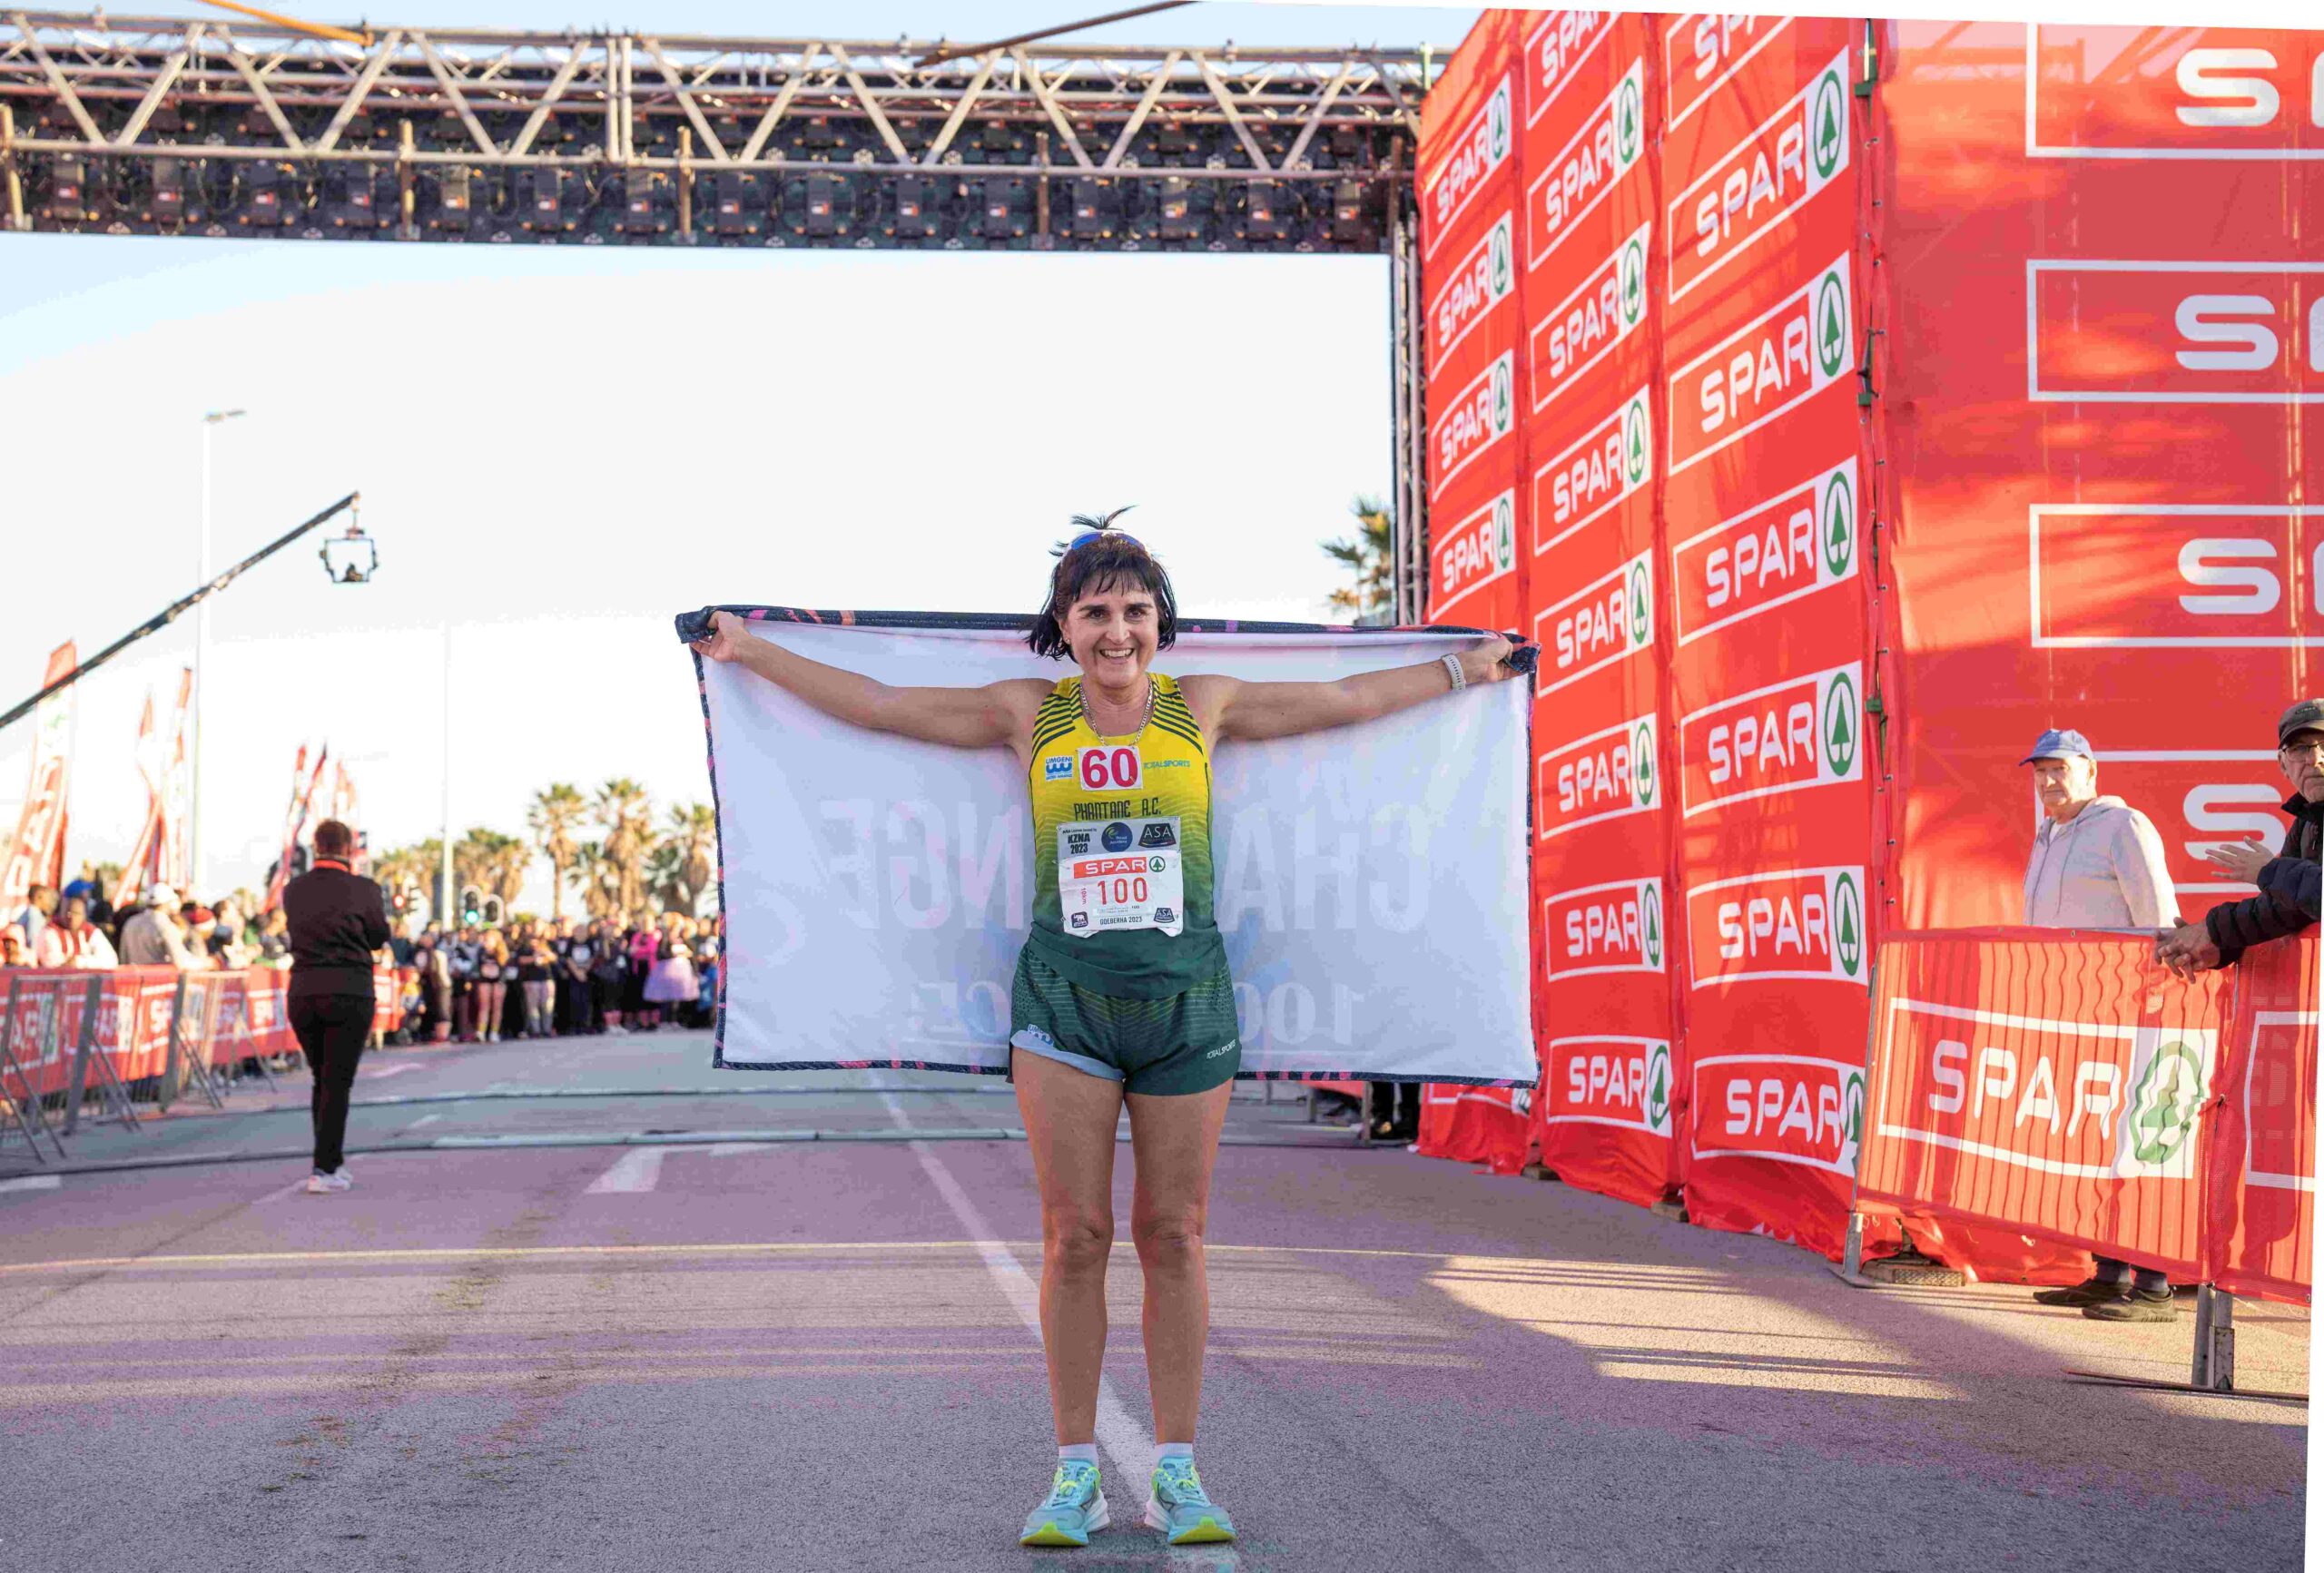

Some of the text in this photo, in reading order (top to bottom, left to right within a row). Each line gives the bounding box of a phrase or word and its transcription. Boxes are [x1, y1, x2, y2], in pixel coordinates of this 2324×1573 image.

[2175, 48, 2324, 128] S
[1437, 125, 1489, 224] SPAR
[1546, 119, 1614, 232] SPAR
[1697, 122, 1804, 257] SPAR
[1439, 255, 1490, 349] SPAR
[1550, 284, 1618, 378] SPAR
[2175, 295, 2324, 372] S
[1701, 315, 1809, 433] SPAR
[1441, 391, 1491, 470] SPAR
[1553, 431, 1622, 524] SPAR
[1443, 516, 1493, 593] SPAR
[1707, 508, 1814, 607] SPAR
[2179, 538, 2324, 614] S
[1557, 581, 1627, 668] SPAR
[1082, 748, 1138, 788] 60
[1144, 760, 1190, 770] TOTALSPORTS
[1559, 741, 1630, 812] SPAR
[1709, 702, 1814, 783] SPAR
[1068, 833, 1090, 843] KZNA
[1141, 797, 1161, 816] A.C.
[1144, 825, 1171, 838] ASA
[1070, 843, 1088, 854] 2023
[1085, 860, 1146, 875] SPAR
[1098, 877, 1147, 905] 100
[1157, 909, 1172, 917] ASA
[1567, 900, 1640, 957] SPAR
[1718, 894, 1827, 959] SPAR
[1206, 1038, 1236, 1059] TOTALSPORTS
[1569, 1057, 1645, 1106] SPAR
[1726, 1079, 1840, 1147] SPAR
[1929, 1040, 2122, 1140] SPAR
